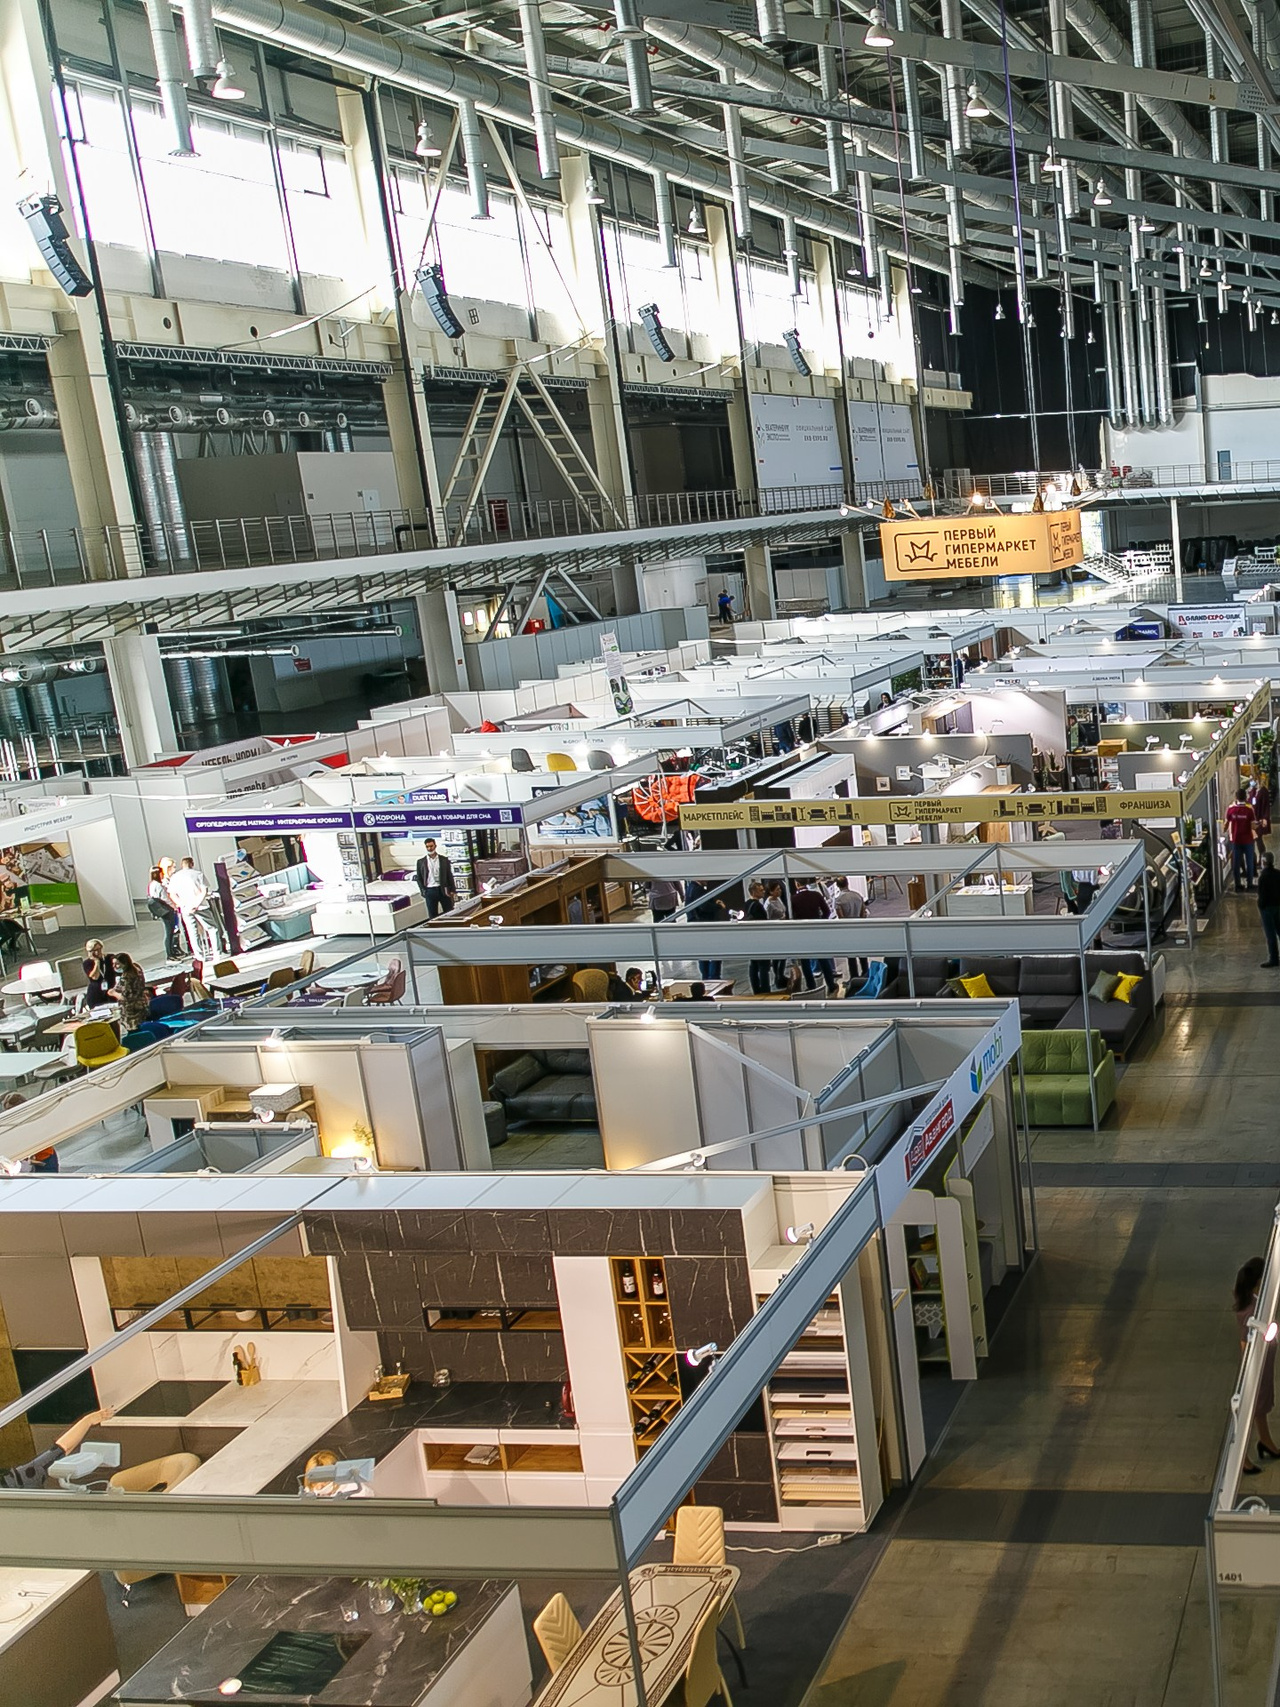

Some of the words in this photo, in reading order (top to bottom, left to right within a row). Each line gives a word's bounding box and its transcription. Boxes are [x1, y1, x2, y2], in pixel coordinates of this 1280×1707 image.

[944, 526, 996, 542] ПЕРВЫЙ
[945, 539, 1036, 555] ГИПЕРМАРКЕТ
[948, 556, 999, 569] МЕБЕЛИ
[914, 800, 942, 808] ПЕРВЫЙ
[915, 806, 962, 814] ГИПЕРМАРКЕТ
[1119, 800, 1171, 810] ФРАНШИЗА
[683, 806, 744, 821] МАРКЕТПЛЕЙС
[915, 814, 943, 822] МЕБЕЛИ
[24, 819, 54, 832] ИНДУСТРИЯ
[53, 815, 73, 826] МЕБЕЛИ
[195, 820, 248, 828] ОРТОПЕДИЧЕСКИЕ
[983, 1027, 1004, 1074] mobi
[925, 1107, 953, 1150] Авангард
[1219, 1572, 1242, 1582] 1401
